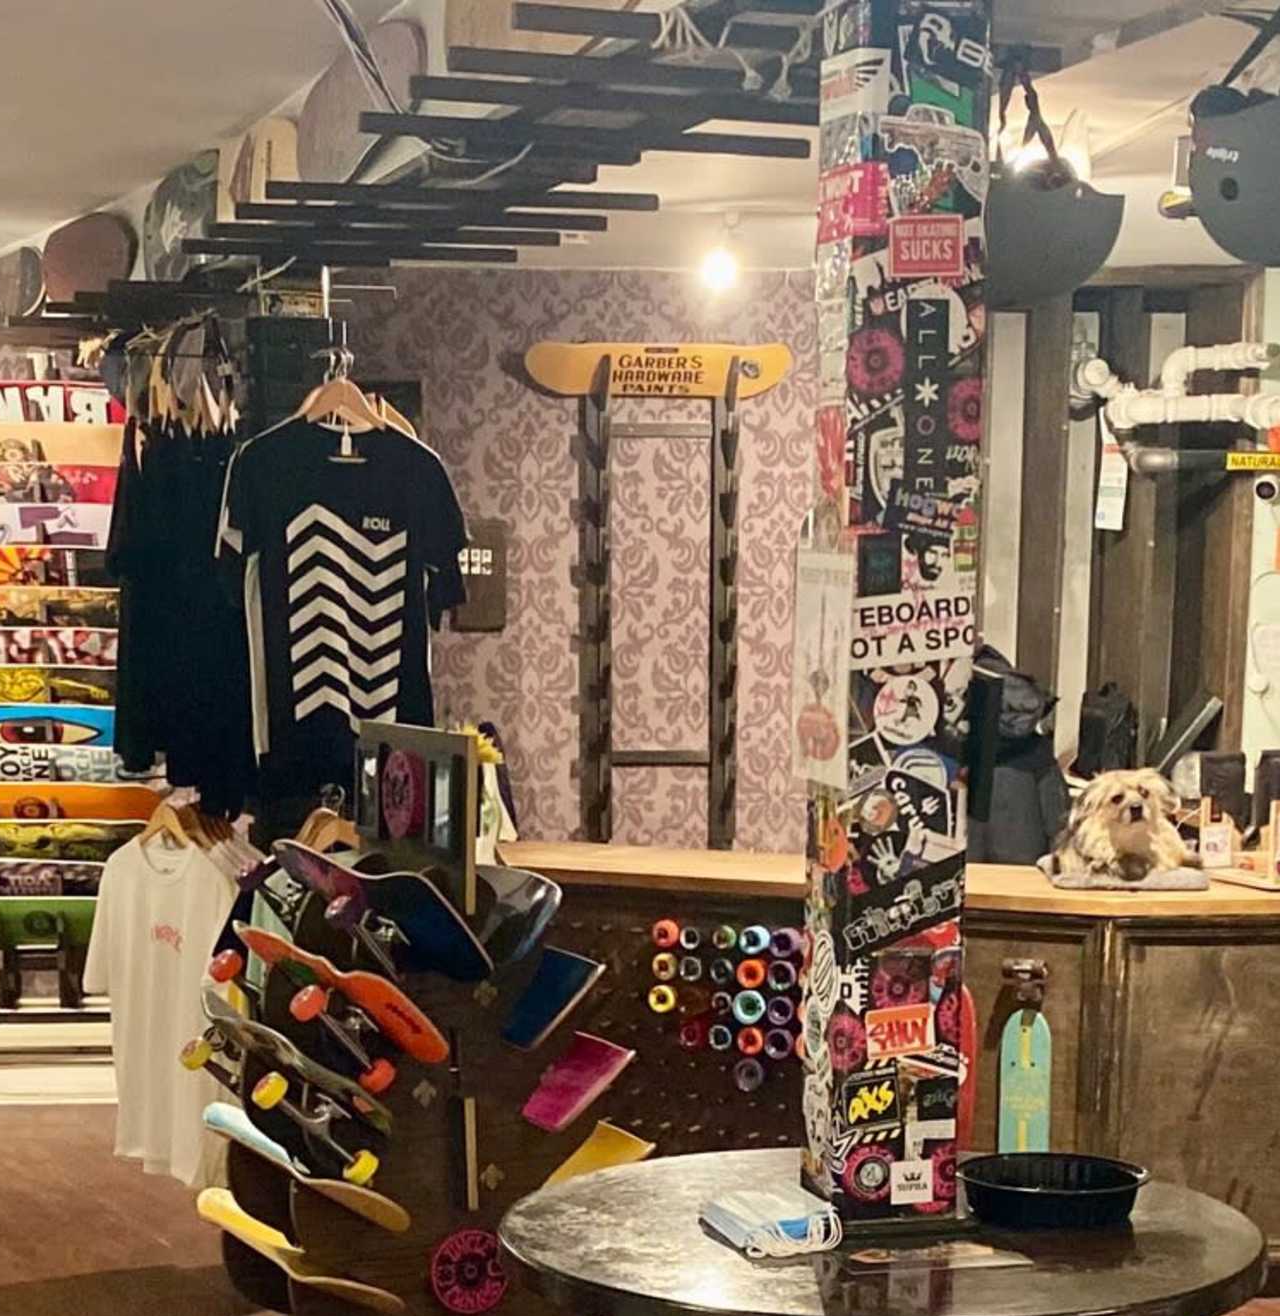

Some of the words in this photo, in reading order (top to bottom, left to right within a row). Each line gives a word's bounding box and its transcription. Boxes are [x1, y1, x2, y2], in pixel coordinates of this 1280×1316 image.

[900, 238, 953, 261] SUCKS
[612, 370, 705, 384] HARDWARE
[621, 384, 691, 394] PAINTS
[363, 517, 391, 532] ROLL
[853, 596, 971, 628] EBOARD
[898, 633, 916, 654] A
[896, 1183, 928, 1192] SUPRA
